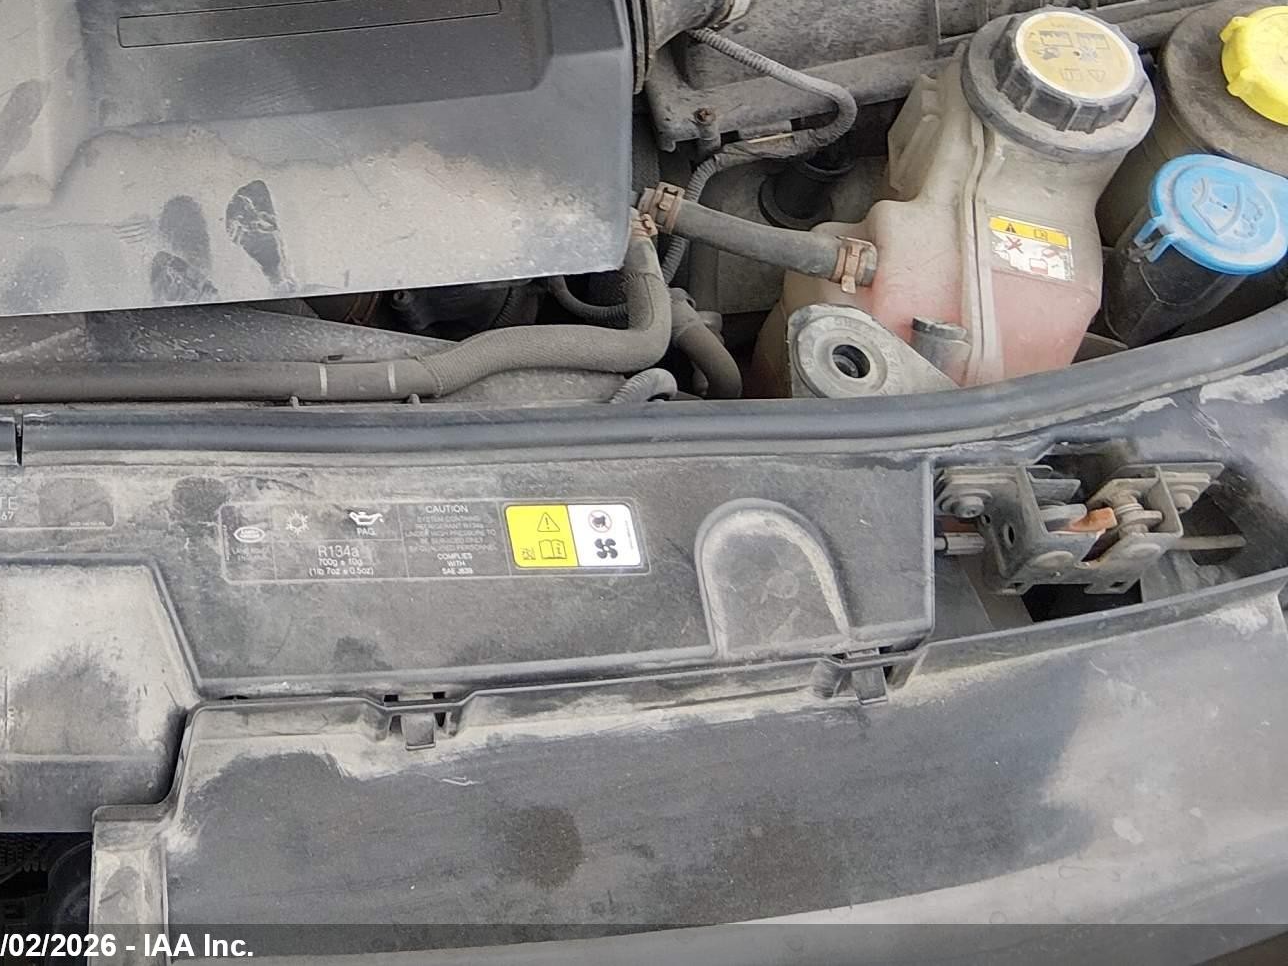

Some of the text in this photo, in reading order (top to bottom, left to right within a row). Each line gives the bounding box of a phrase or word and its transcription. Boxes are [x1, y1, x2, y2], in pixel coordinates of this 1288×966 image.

[425, 504, 469, 514] CAUTION
[317, 544, 360, 558] R134a
[318, 558, 338, 567] 700g
[326, 567, 341, 575] 7oz
